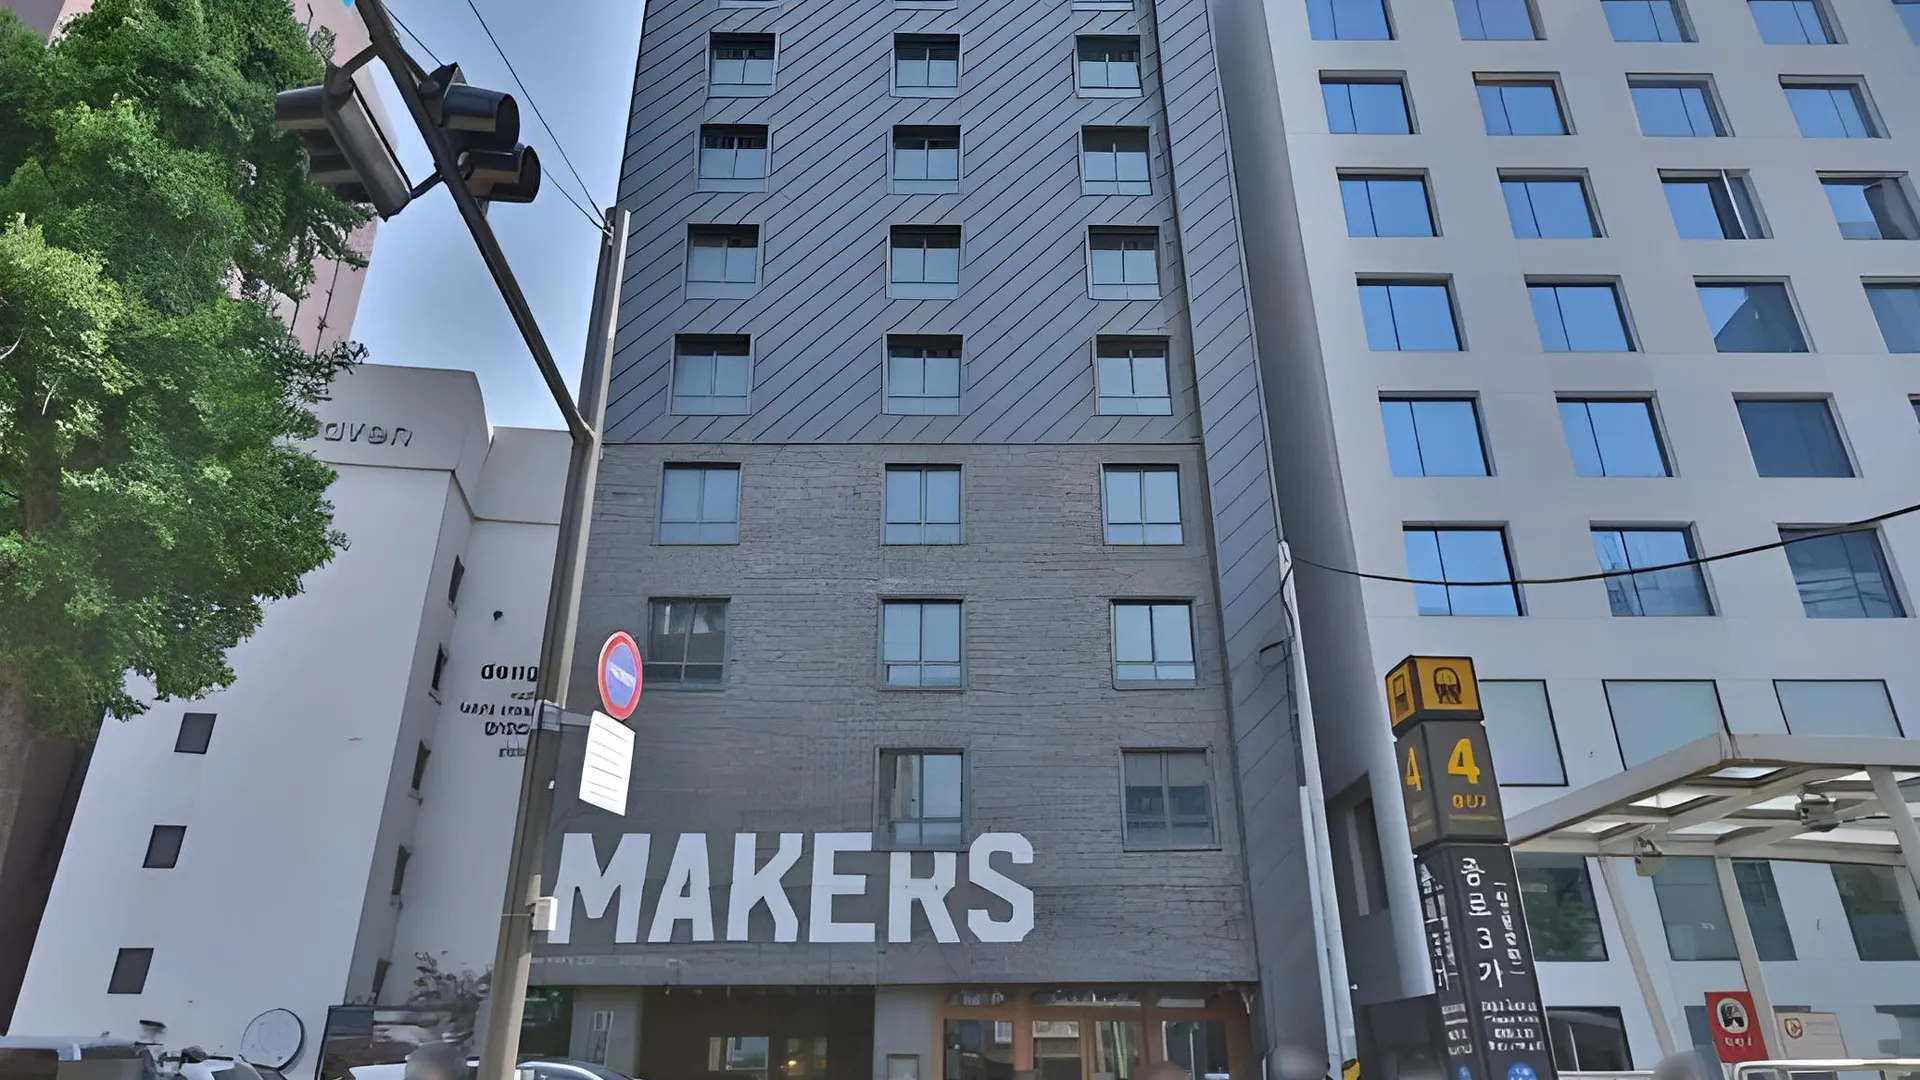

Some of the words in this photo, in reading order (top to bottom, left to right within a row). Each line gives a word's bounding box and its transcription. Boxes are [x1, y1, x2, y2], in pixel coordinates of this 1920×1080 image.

[1406, 746, 1422, 791] 4
[1447, 738, 1480, 784] 4
[547, 832, 1035, 944] MAKERS
